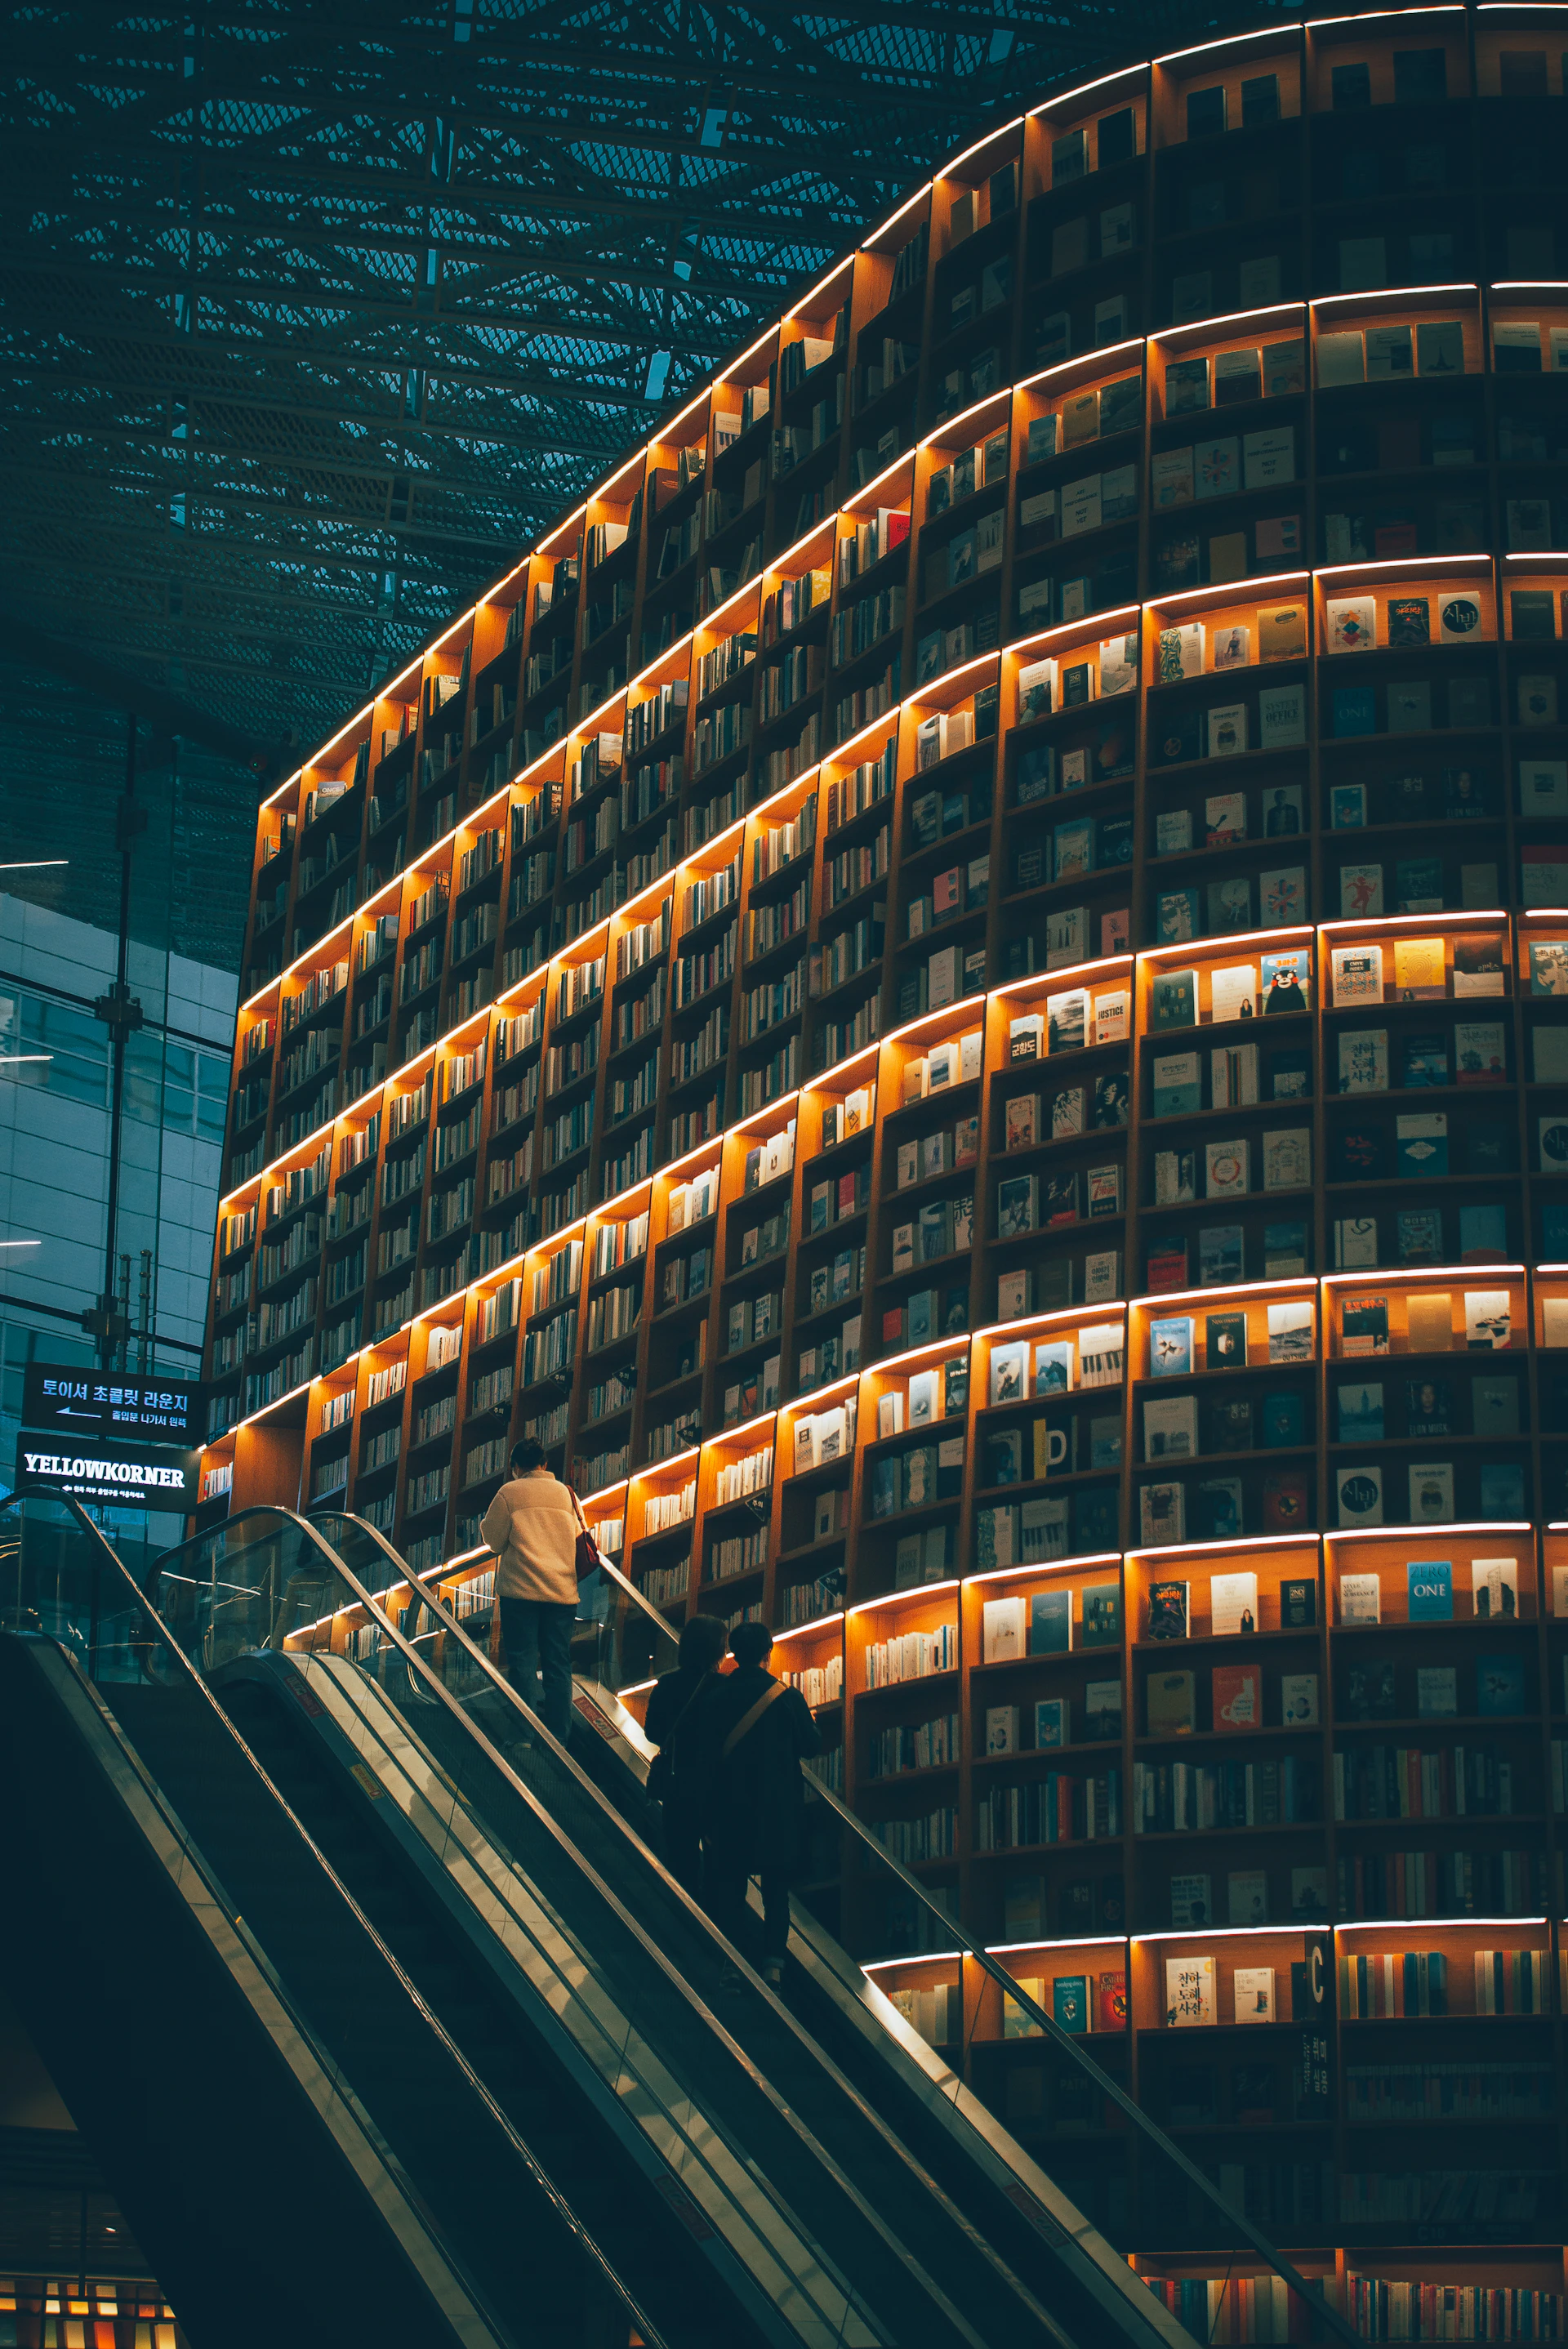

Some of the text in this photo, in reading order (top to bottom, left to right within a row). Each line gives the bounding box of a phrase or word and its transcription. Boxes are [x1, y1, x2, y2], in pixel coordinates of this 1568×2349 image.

[1247, 445, 1290, 457] PERFORMANCE
[1261, 459, 1276, 467] NOT
[1064, 492, 1098, 508] PERFORMANCE
[1075, 507, 1088, 516] NOT
[1076, 515, 1087, 524] YET
[1443, 604, 1479, 631] 시밤
[1265, 708, 1298, 722] OFFICE
[1339, 706, 1370, 720] ONE
[1103, 820, 1132, 831] Cardiology
[1098, 1005, 1124, 1020] JUSTICE
[1012, 1040, 1036, 1058] 군함도
[1282, 1352, 1307, 1362] OUTSIDE
[42, 1380, 188, 1412] 토이셔 초콜릿 라운지
[112, 1410, 187, 1428] 출입문 나가서 왼쪽
[1409, 1423, 1449, 1435] ELON MUSK
[24, 1453, 185, 1489] YELLOWKORNER
[1410, 1565, 1449, 1578] ZERO
[1414, 1584, 1446, 1598] ONE
[1178, 1972, 1201, 1987] 철학
[1312, 1946, 1324, 2004] C
[1178, 1987, 1200, 2002] 도해
[1178, 2001, 1201, 2017] 사전
